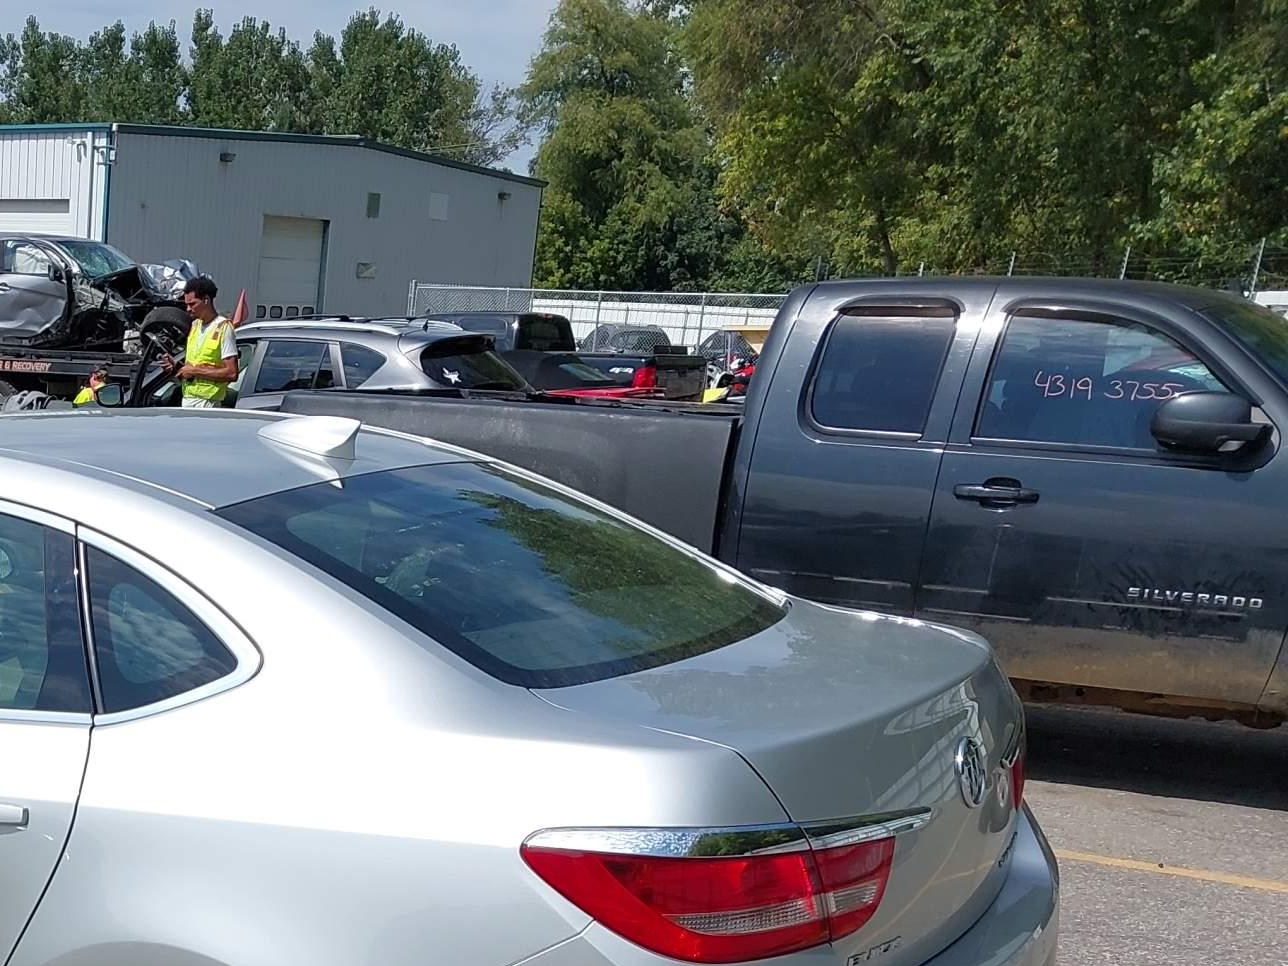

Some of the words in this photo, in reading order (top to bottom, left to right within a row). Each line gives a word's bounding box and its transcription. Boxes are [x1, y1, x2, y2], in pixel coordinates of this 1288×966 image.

[12, 361, 52, 371] RECOVERY
[1033, 371, 1093, 400] 4319
[1103, 380, 1185, 401] 3755
[1127, 587, 1263, 609] SILVERADO
